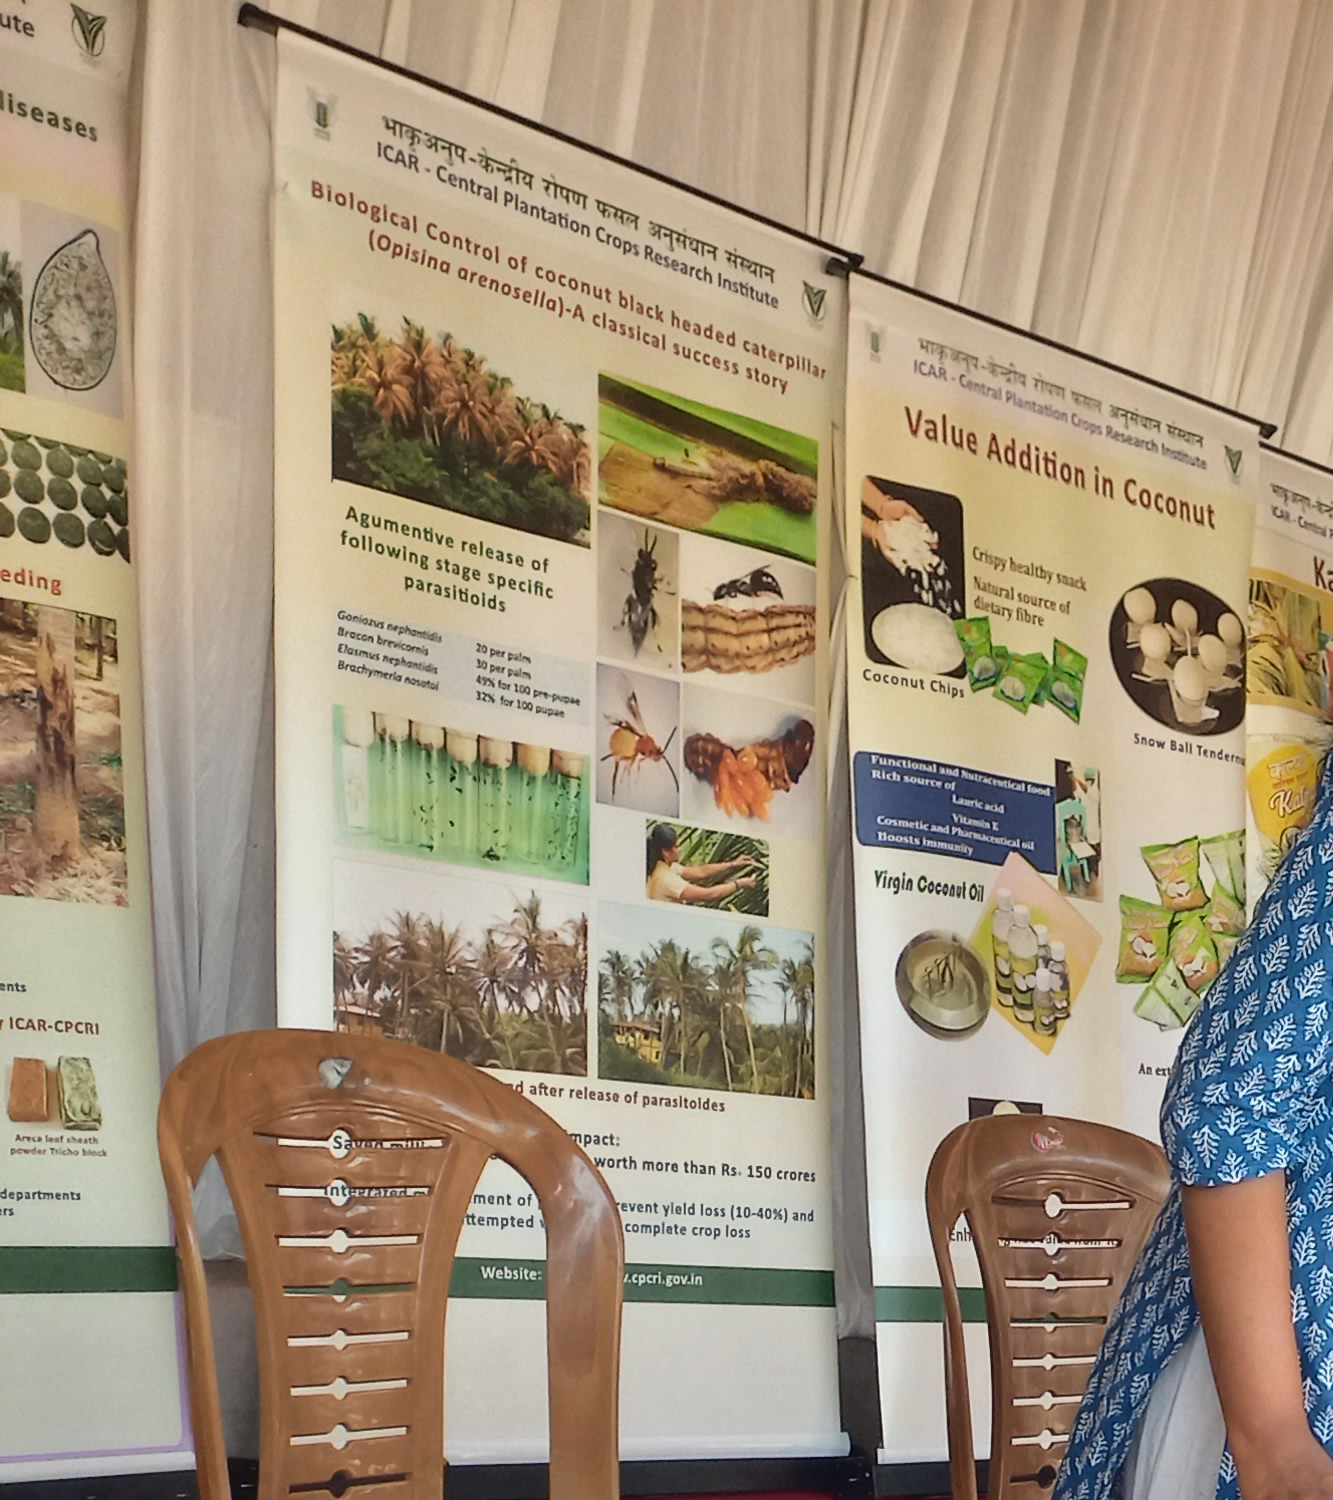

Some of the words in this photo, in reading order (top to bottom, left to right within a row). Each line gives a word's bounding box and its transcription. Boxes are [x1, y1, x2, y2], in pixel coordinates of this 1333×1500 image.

[377, 142, 419, 173] ICAR
[436, 165, 498, 203] Central
[503, 191, 590, 238] Plantation
[595, 226, 640, 256] Crops
[644, 244, 713, 284] Research
[717, 272, 779, 309] Institute
[311, 179, 417, 233] Biological
[426, 222, 500, 264] Control
[507, 255, 527, 273] of
[535, 265, 611, 304] coconut
[618, 290, 664, 323] black
[671, 309, 736, 347] headed
[743, 338, 826, 380] caterpillar
[369, 229, 450, 275] (Opisina
[458, 266, 585, 322] arenosella)-A
[592, 312, 666, 351] classical
[673, 342, 739, 375] success
[746, 365, 788, 395] story
[914, 360, 947, 381] ICAR
[959, 374, 1002, 400] Central
[1005, 390, 1068, 423] Plantation
[1071, 413, 1103, 435] Crops
[1106, 425, 1158, 452] Research
[1162, 443, 1207, 470] Institute
[904, 406, 977, 455] Value
[987, 432, 1086, 490] Addition
[1094, 466, 1114, 500] in
[1124, 478, 1215, 530] Coconut
[346, 506, 454, 548] Agumentive
[461, 540, 524, 568] release
[531, 558, 549, 574] of
[340, 530, 429, 570] following
[436, 557, 481, 581] stage
[488, 572, 554, 599] specific
[973, 546, 1007, 572] Crispy
[1010, 556, 1054, 584] healthy
[1056, 573, 1087, 592] snack
[0, 568, 62, 596] eding
[404, 575, 506, 613] parasitioids
[973, 575, 1014, 600] Natural
[1017, 592, 1057, 611] source
[1059, 601, 1071, 615] of
[974, 596, 1013, 621] dietary
[1016, 607, 1045, 627] fibre
[490, 648, 505, 658] per
[508, 652, 531, 664] palm
[490, 664, 505, 674] per
[508, 668, 531, 680] palm
[862, 668, 925, 690] Coconut
[930, 680, 965, 699] Chips
[498, 679, 511, 691] for
[514, 683, 531, 696] 100
[500, 695, 514, 707] for
[516, 699, 533, 711] 100
[1134, 733, 1166, 749] Snow
[1170, 740, 1193, 755] Ball
[871, 754, 937, 777] Functional
[939, 766, 960, 778] and
[1027, 784, 1051, 797] food
[871, 769, 901, 782] Rich
[903, 774, 943, 789] source
[944, 781, 956, 791] of
[952, 794, 983, 810] Lauric
[984, 801, 1005, 814] acid
[876, 815, 929, 832] Cosmetic
[930, 823, 950, 835] and
[1021, 841, 1035, 851] oil
[952, 813, 991, 829] Vitamin
[992, 821, 999, 832] E
[877, 831, 921, 846] Boosts
[922, 837, 974, 857] immunity
[874, 870, 913, 895] Virgin
[917, 875, 966, 899] Coconut
[969, 883, 985, 903] Oil
[9, 1016, 99, 1035] ICAR-CPCRI
[1138, 1062, 1152, 1075] An
[505, 1080, 524, 1095] nd
[529, 1082, 565, 1098] after
[569, 1086, 620, 1103] release
[624, 1092, 638, 1105] of
[642, 1094, 726, 1112] parasitoides
[45, 1134, 63, 1143] leaf
[569, 1133, 621, 1147] mpact:
[593, 1155, 638, 1171] worth
[642, 1160, 679, 1174] more
[684, 1161, 716, 1176] than
[747, 1165, 772, 1180] 150
[776, 1169, 816, 1183] crores
[517, 1194, 532, 1207] of
[662, 1203, 696, 1218] yield
[700, 1204, 726, 1218] loss
[730, 1205, 789, 1223] (10-40%)
[792, 1210, 814, 1223] and
[466, 1213, 534, 1230] ttempted
[624, 1221, 687, 1238] complete
[691, 1225, 721, 1240] crop
[725, 1224, 751, 1239] loss
[480, 1265, 542, 1281] Website:
